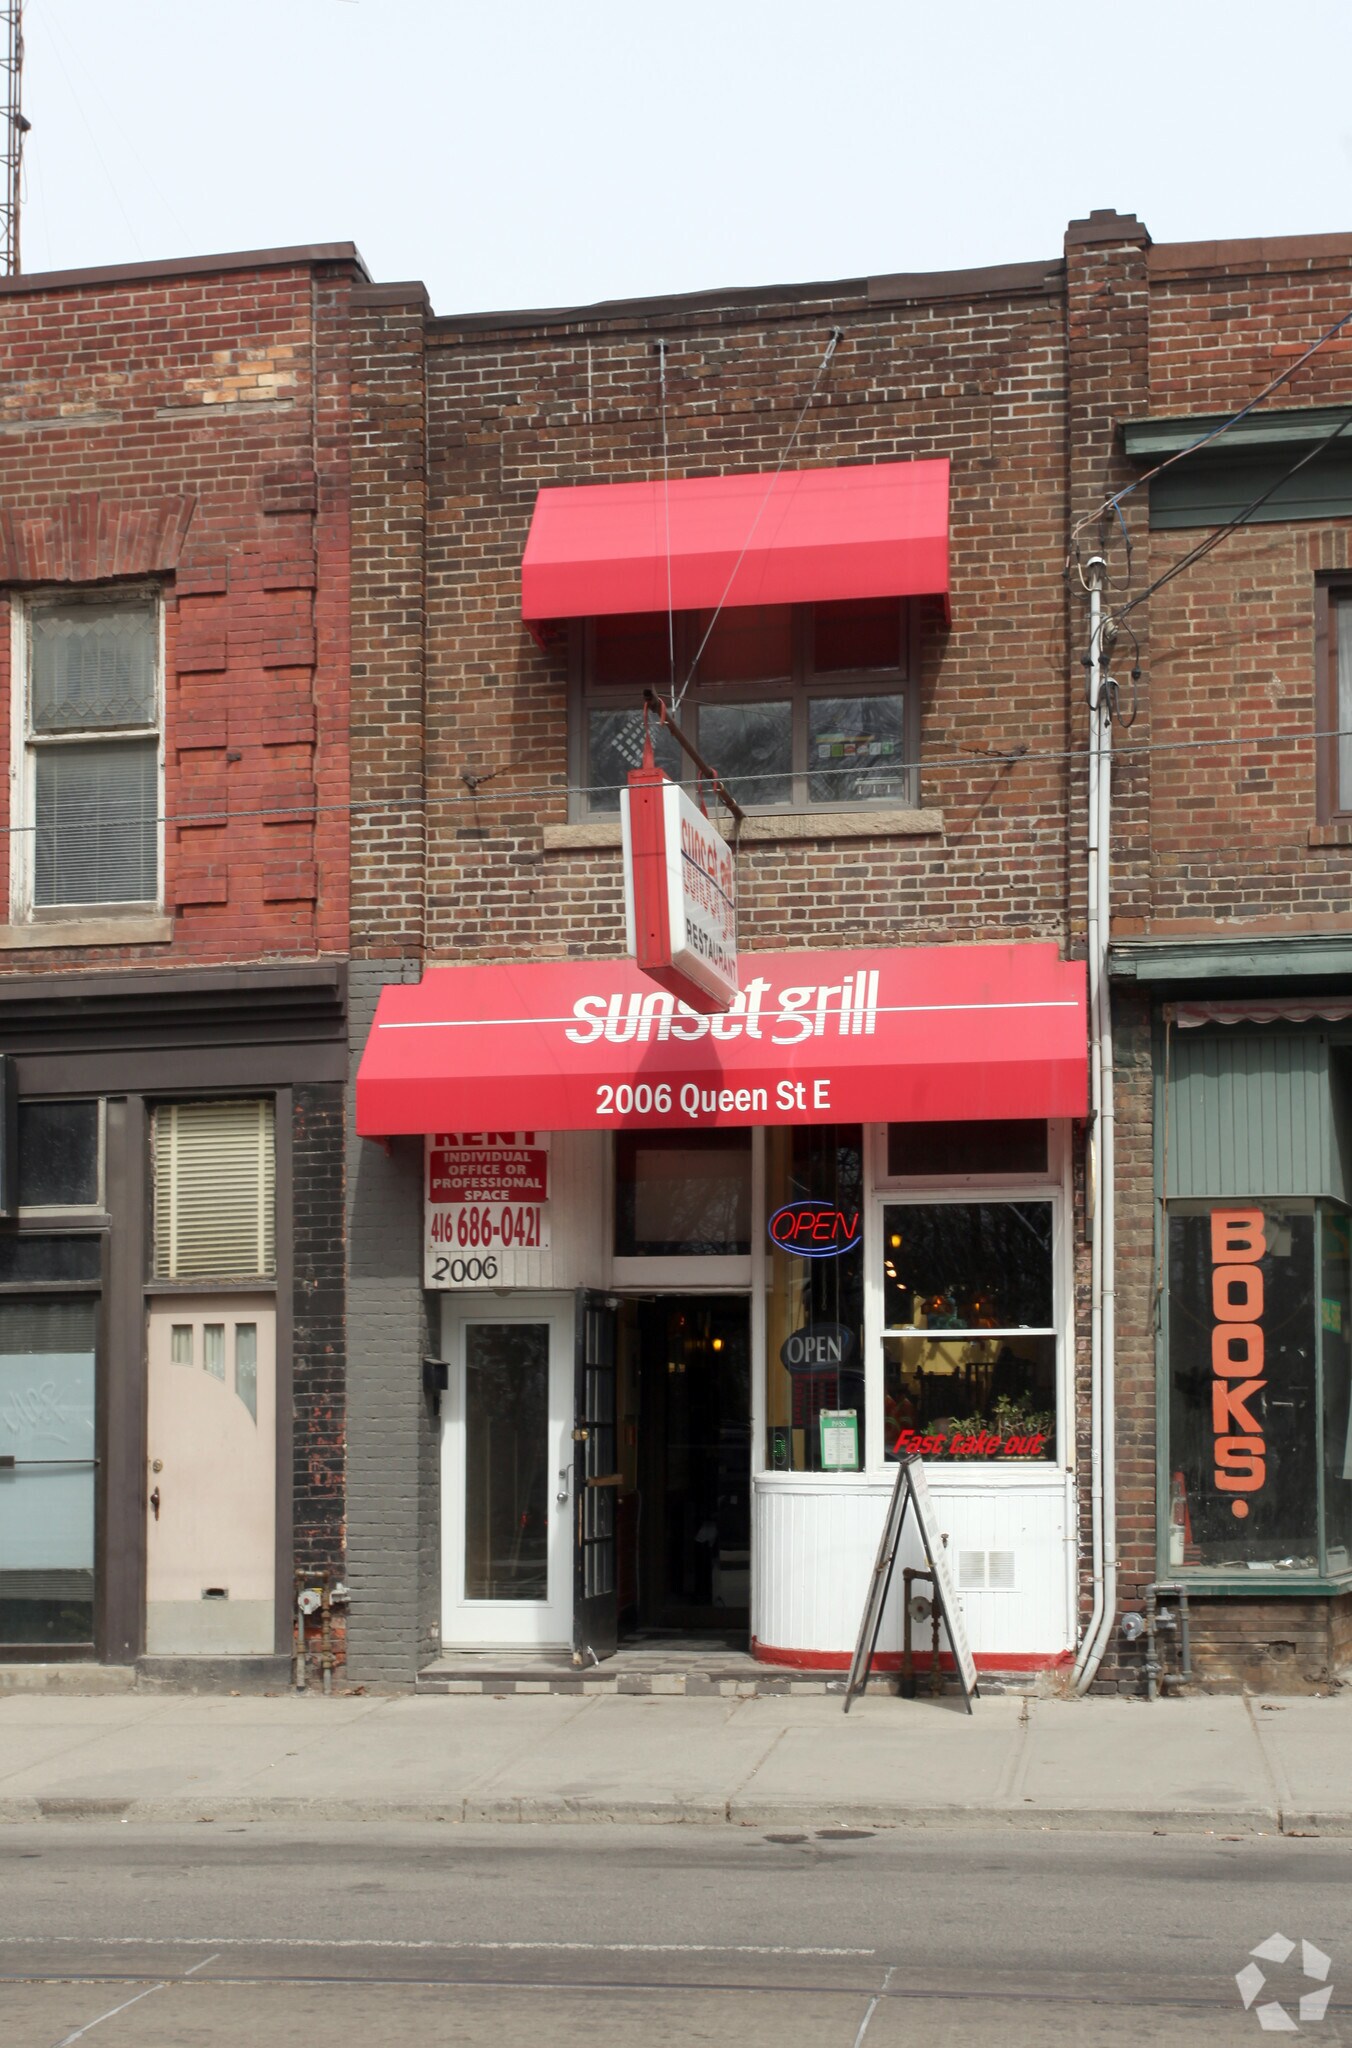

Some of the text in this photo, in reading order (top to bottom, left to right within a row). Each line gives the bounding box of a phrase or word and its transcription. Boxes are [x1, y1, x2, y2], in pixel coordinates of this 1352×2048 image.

[686, 918, 736, 982] RESTAURANT
[565, 970, 879, 1045] sunset grill
[596, 1079, 831, 1118] 2006 Queen St E
[444, 1152, 532, 1163] INDIVIDUAL
[448, 1165, 527, 1176] OFFICE OR
[432, 1178, 543, 1189] PROFESSIONAL
[464, 1190, 510, 1201] SPACE
[431, 1206, 541, 1247] 416 686-0421
[772, 1211, 859, 1241] OPEN
[431, 1256, 498, 1282] 2006
[786, 1335, 843, 1364] OPEN
[893, 1429, 1047, 1456] Fast take out
